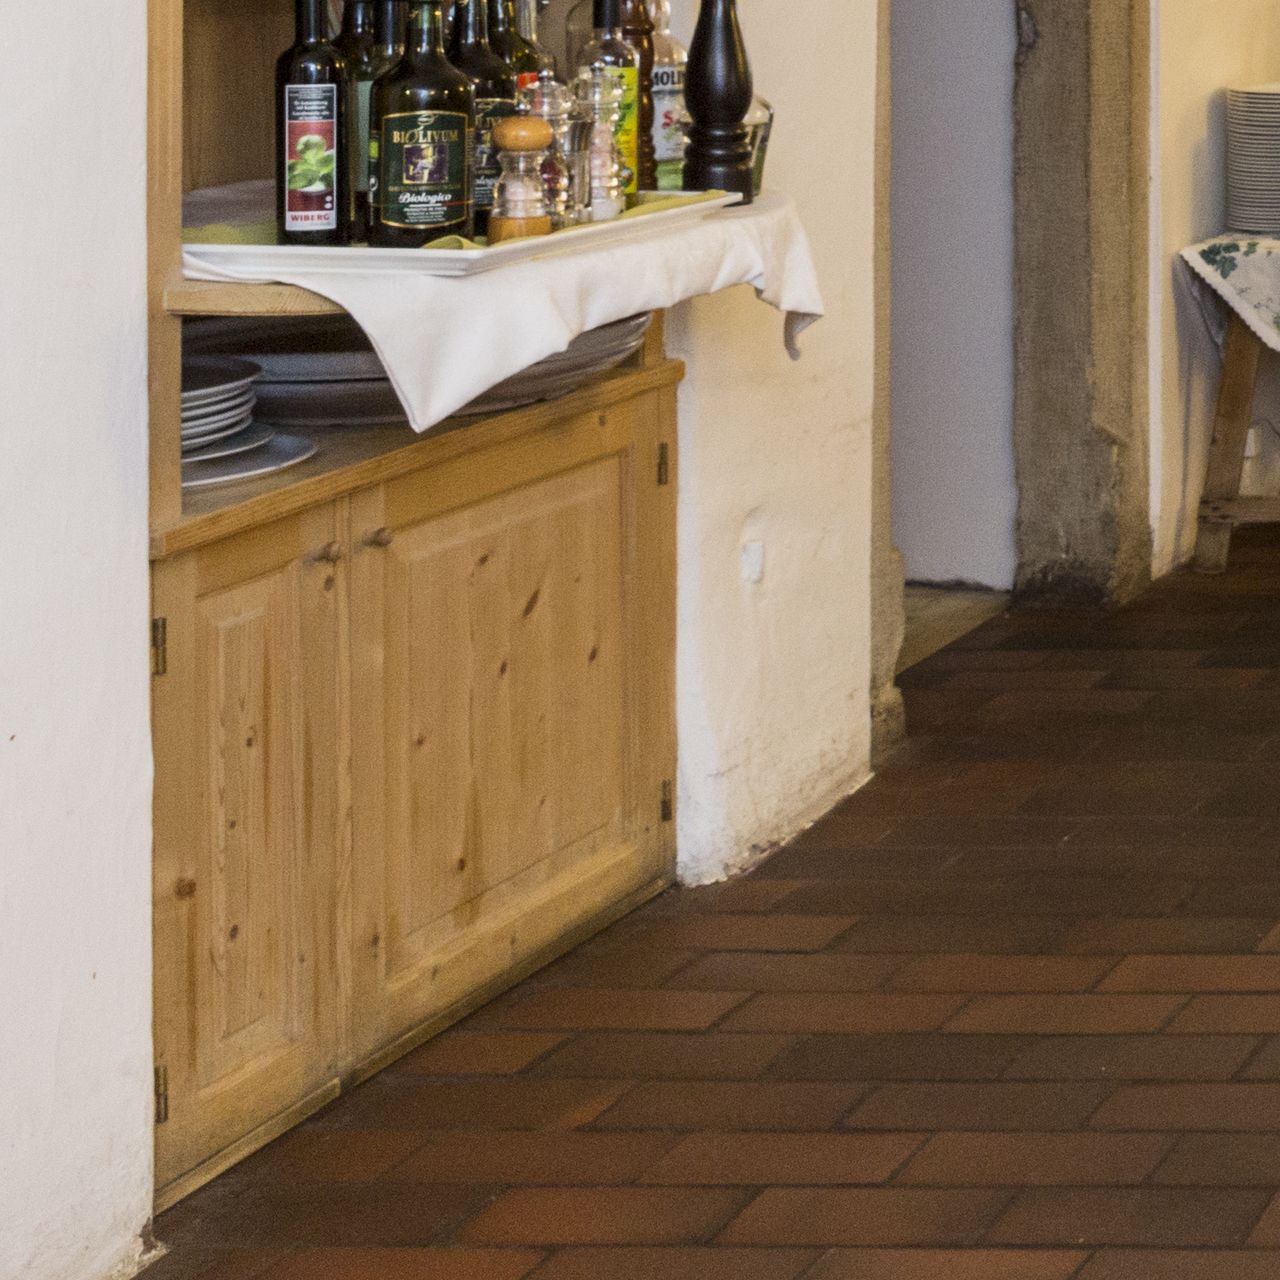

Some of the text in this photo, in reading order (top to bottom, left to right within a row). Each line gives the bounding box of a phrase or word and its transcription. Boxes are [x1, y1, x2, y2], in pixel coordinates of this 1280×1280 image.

[392, 127, 458, 143] BIOLIVUM
[398, 192, 452, 204] Biologico
[291, 213, 330, 222] WIBERG
